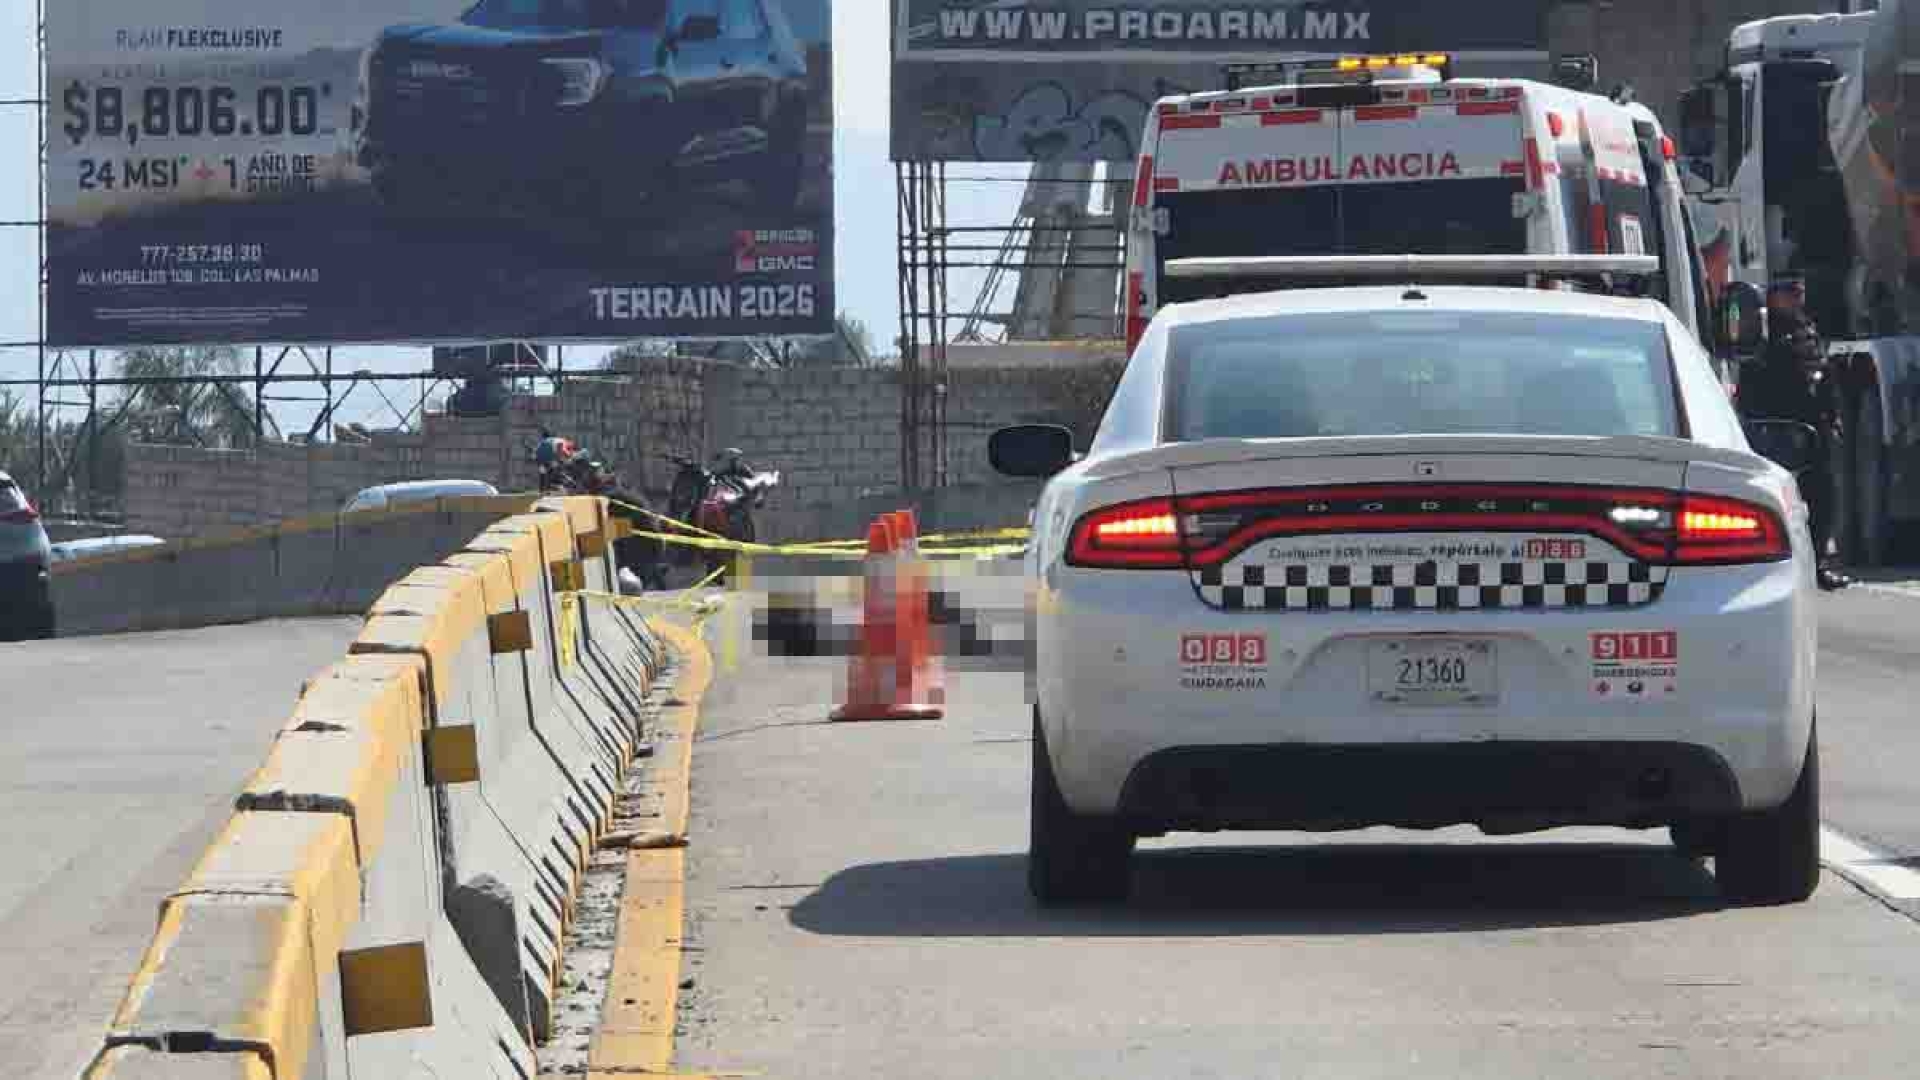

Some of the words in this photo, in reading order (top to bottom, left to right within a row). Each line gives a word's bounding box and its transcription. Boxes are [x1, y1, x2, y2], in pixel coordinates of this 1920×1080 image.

[167, 29, 283, 48] FLEXCLUSIVE
[940, 11, 1371, 40] WWW.PROARM.MX
[78, 158, 115, 189] 24
[223, 158, 236, 190] 1
[247, 149, 287, 173] AÑO
[292, 155, 316, 174] DE
[1218, 151, 1461, 184] AMBULANCIA
[758, 256, 815, 271] GMC
[589, 286, 732, 319] TERRAIN
[739, 284, 815, 318] 2026
[1184, 638, 1263, 663] 088
[1597, 636, 1671, 659] 911
[1399, 658, 1465, 685] 21360
